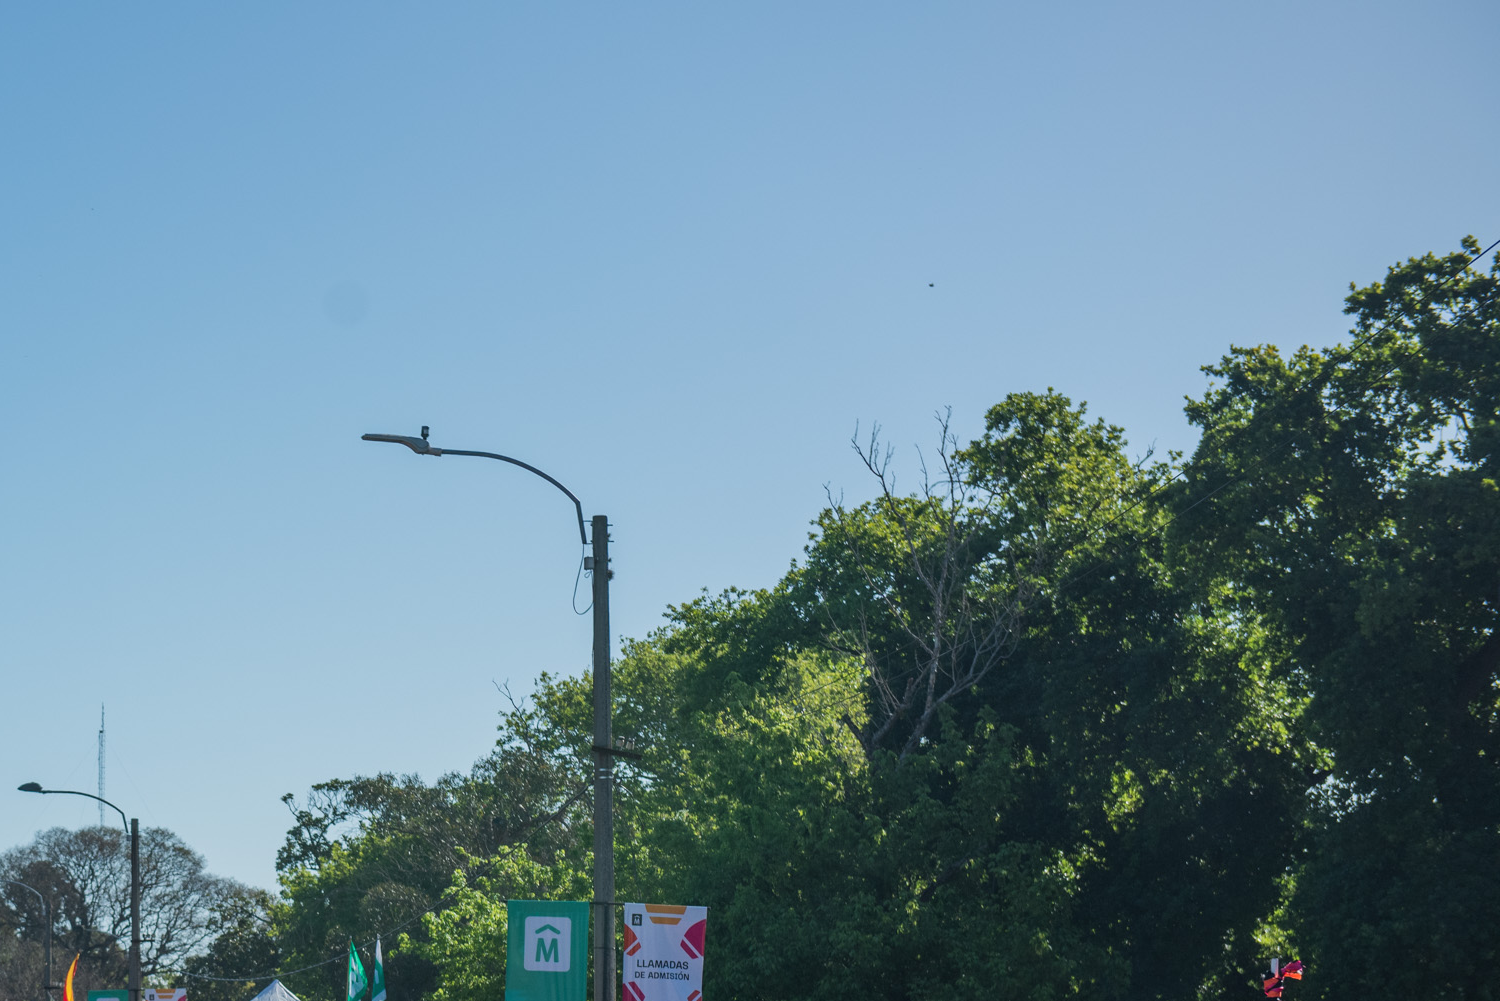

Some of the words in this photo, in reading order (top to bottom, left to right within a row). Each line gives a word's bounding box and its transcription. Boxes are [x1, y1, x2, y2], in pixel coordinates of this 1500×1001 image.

[535, 938, 559, 962] M
[636, 959, 689, 969] LLAMADAS
[634, 971, 646, 979] DE
[647, 970, 690, 981] ADMISIÓN
